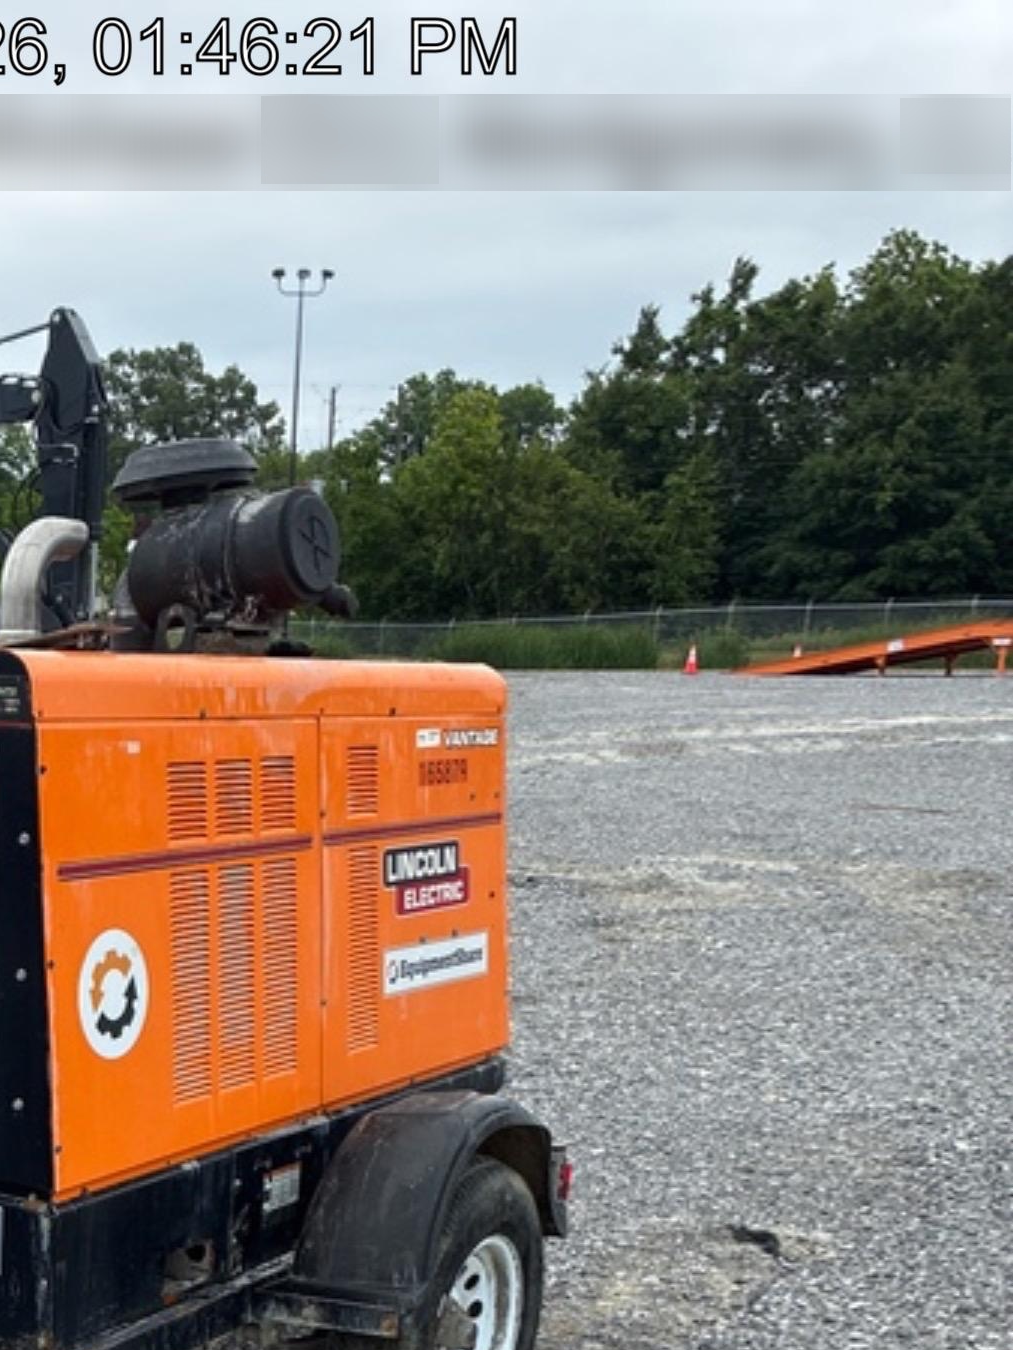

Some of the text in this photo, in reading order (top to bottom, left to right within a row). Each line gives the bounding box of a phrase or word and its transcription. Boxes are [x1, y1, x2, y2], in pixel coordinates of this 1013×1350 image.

[387, 845, 458, 883] LINCOLN
[403, 880, 465, 910] ELECTRIC
[400, 947, 484, 981] EquipmentShare
